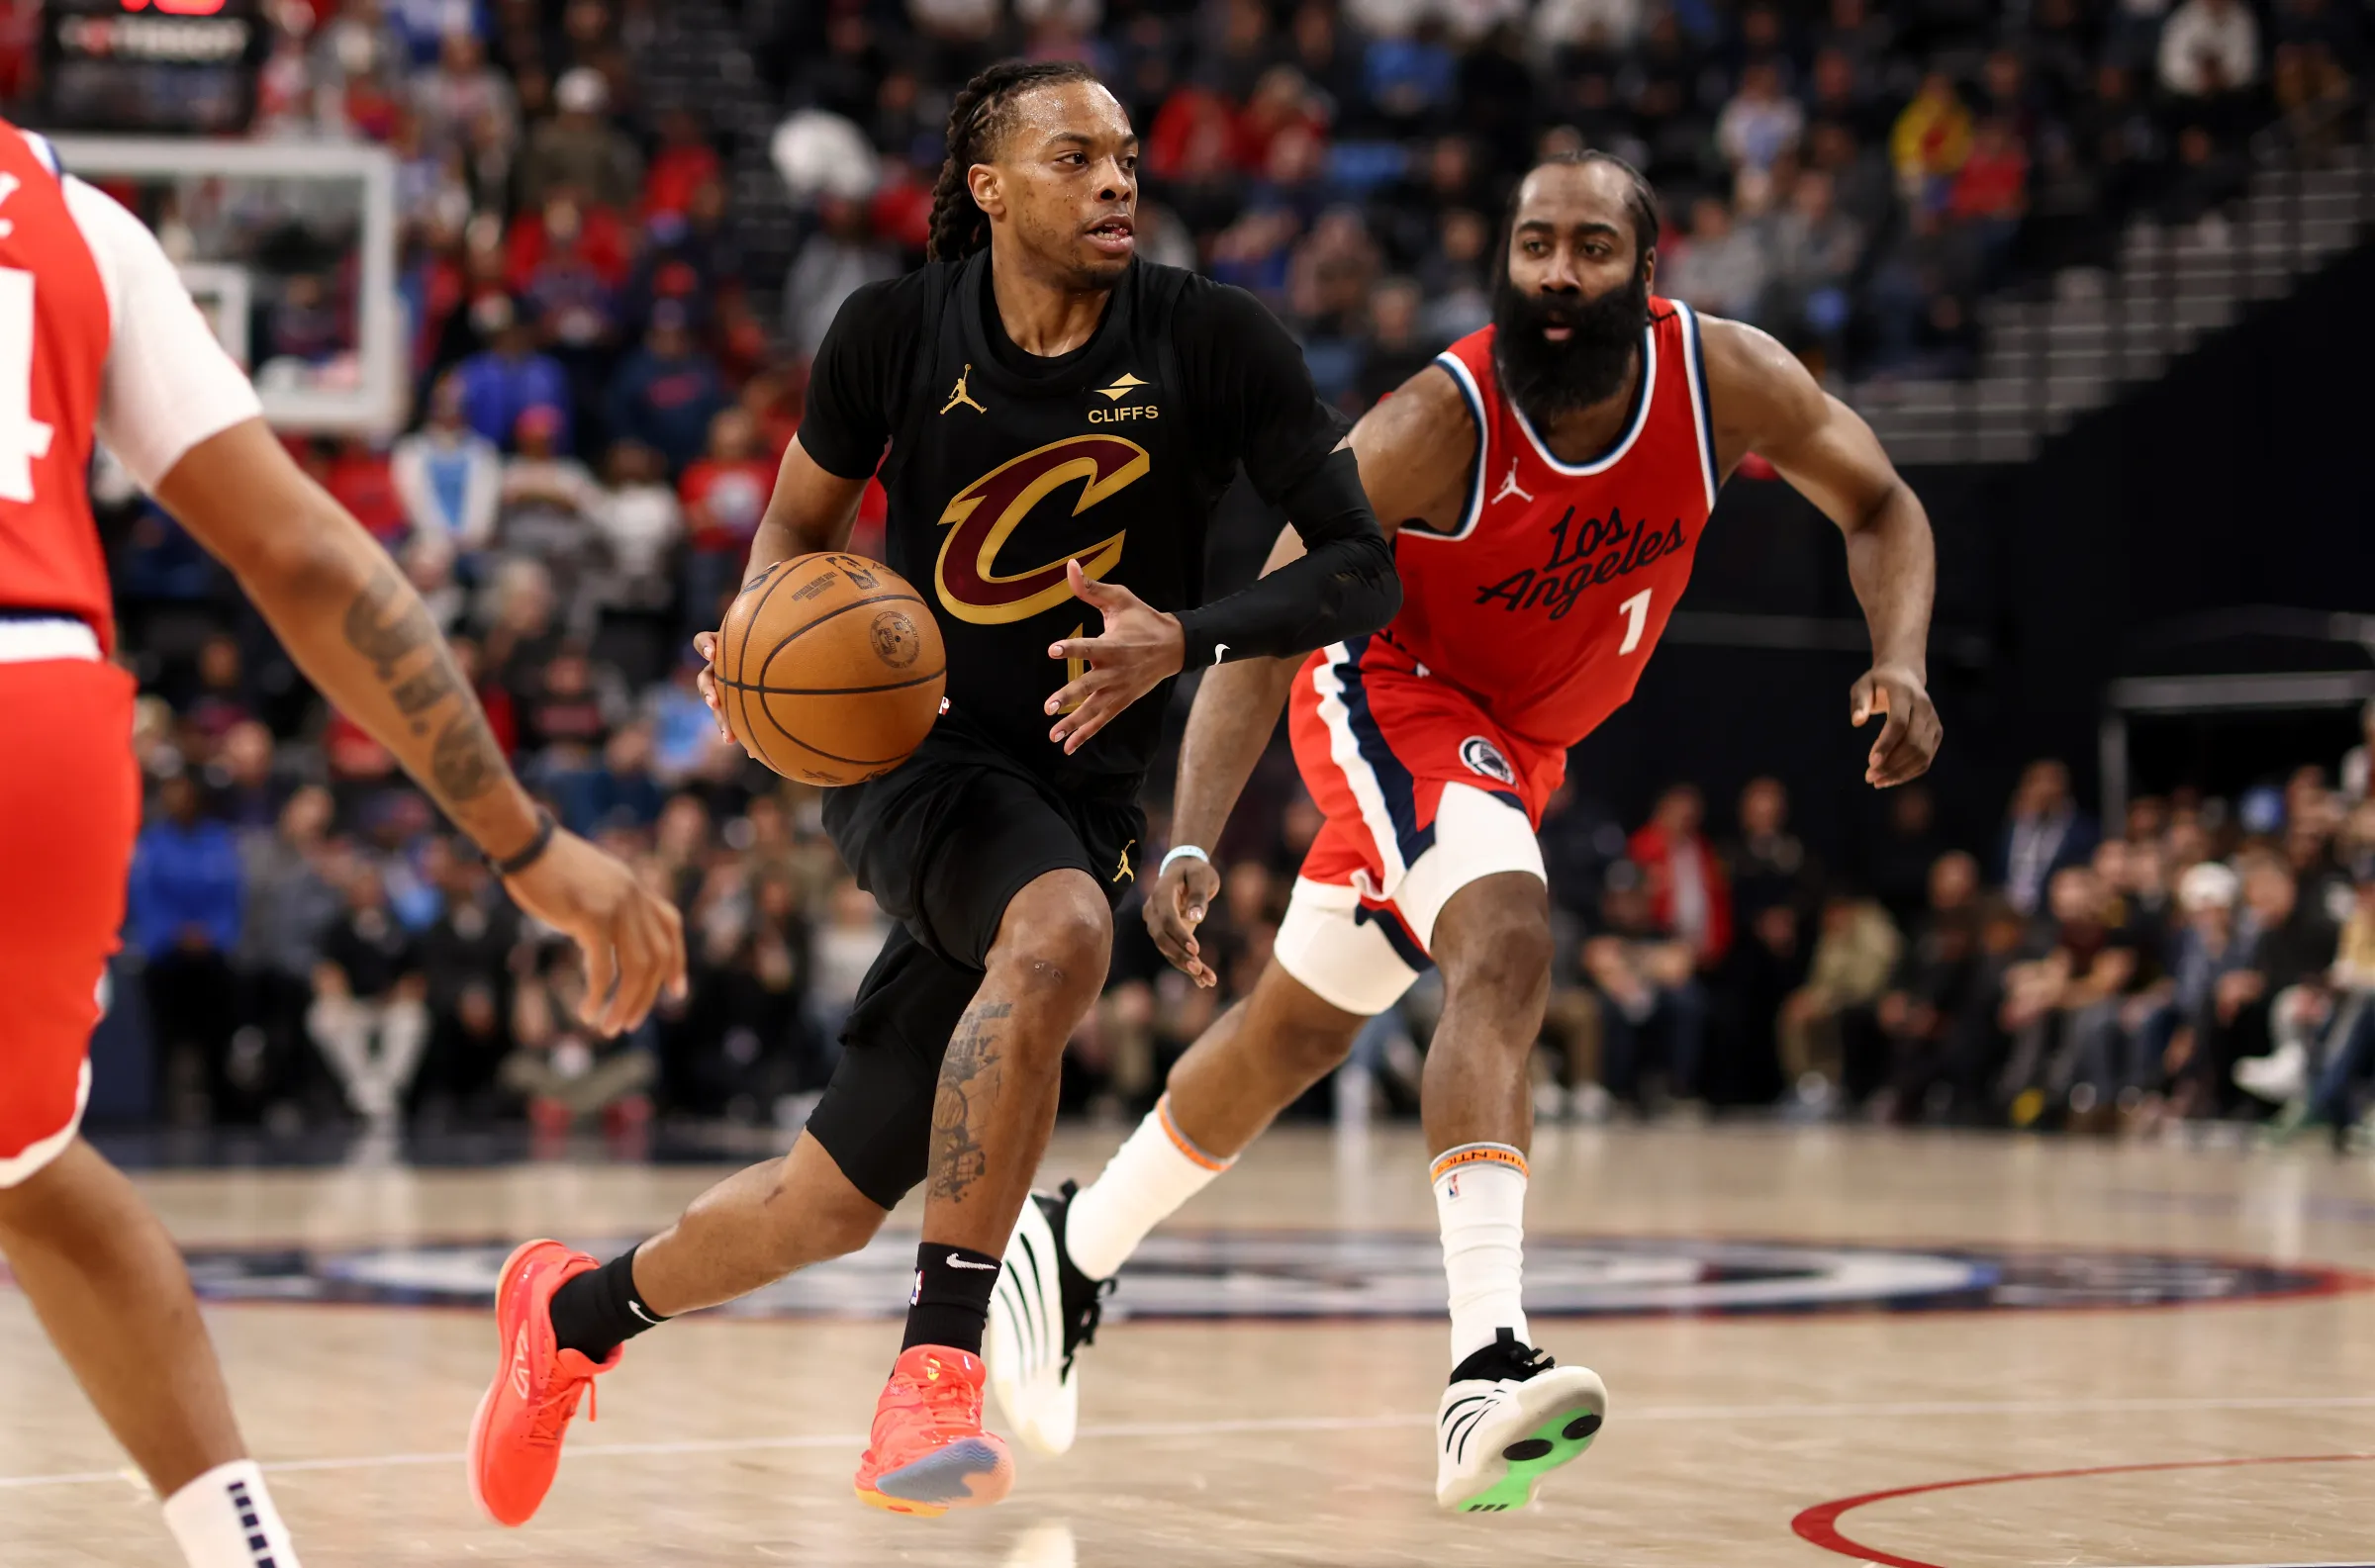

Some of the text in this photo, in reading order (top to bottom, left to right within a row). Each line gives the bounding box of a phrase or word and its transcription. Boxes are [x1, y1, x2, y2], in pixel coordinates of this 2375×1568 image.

[1088, 405, 1159, 424] CLIFFS
[935, 433, 1150, 624] C
[1544, 506, 1631, 572] Los
[1475, 518, 1686, 620] Angeles
[1618, 587, 1653, 657] 1
